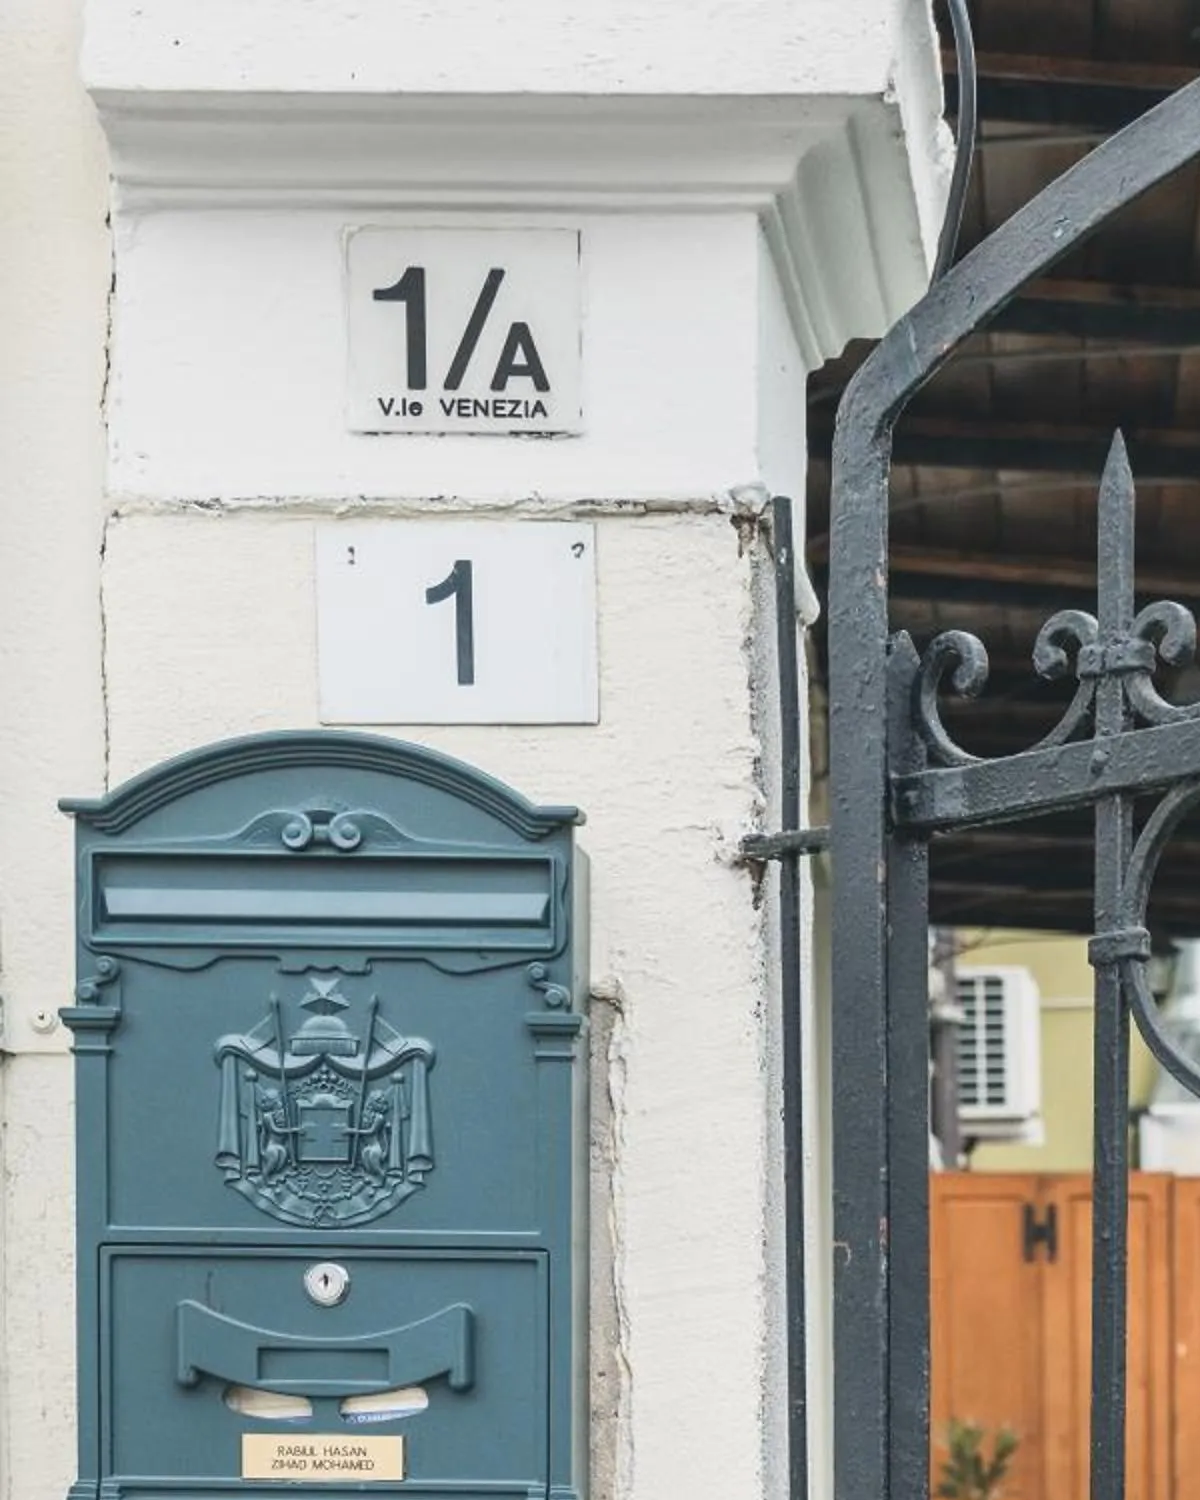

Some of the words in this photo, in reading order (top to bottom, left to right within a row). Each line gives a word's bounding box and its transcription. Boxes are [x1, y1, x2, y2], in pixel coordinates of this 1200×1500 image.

[373, 266, 551, 392] 1/A
[378, 397, 423, 417] V.le
[439, 397, 548, 418] VENEZIA
[426, 559, 474, 684] 1
[323, 1446, 367, 1457] HASAN
[312, 1459, 375, 1471] MOHAMED
